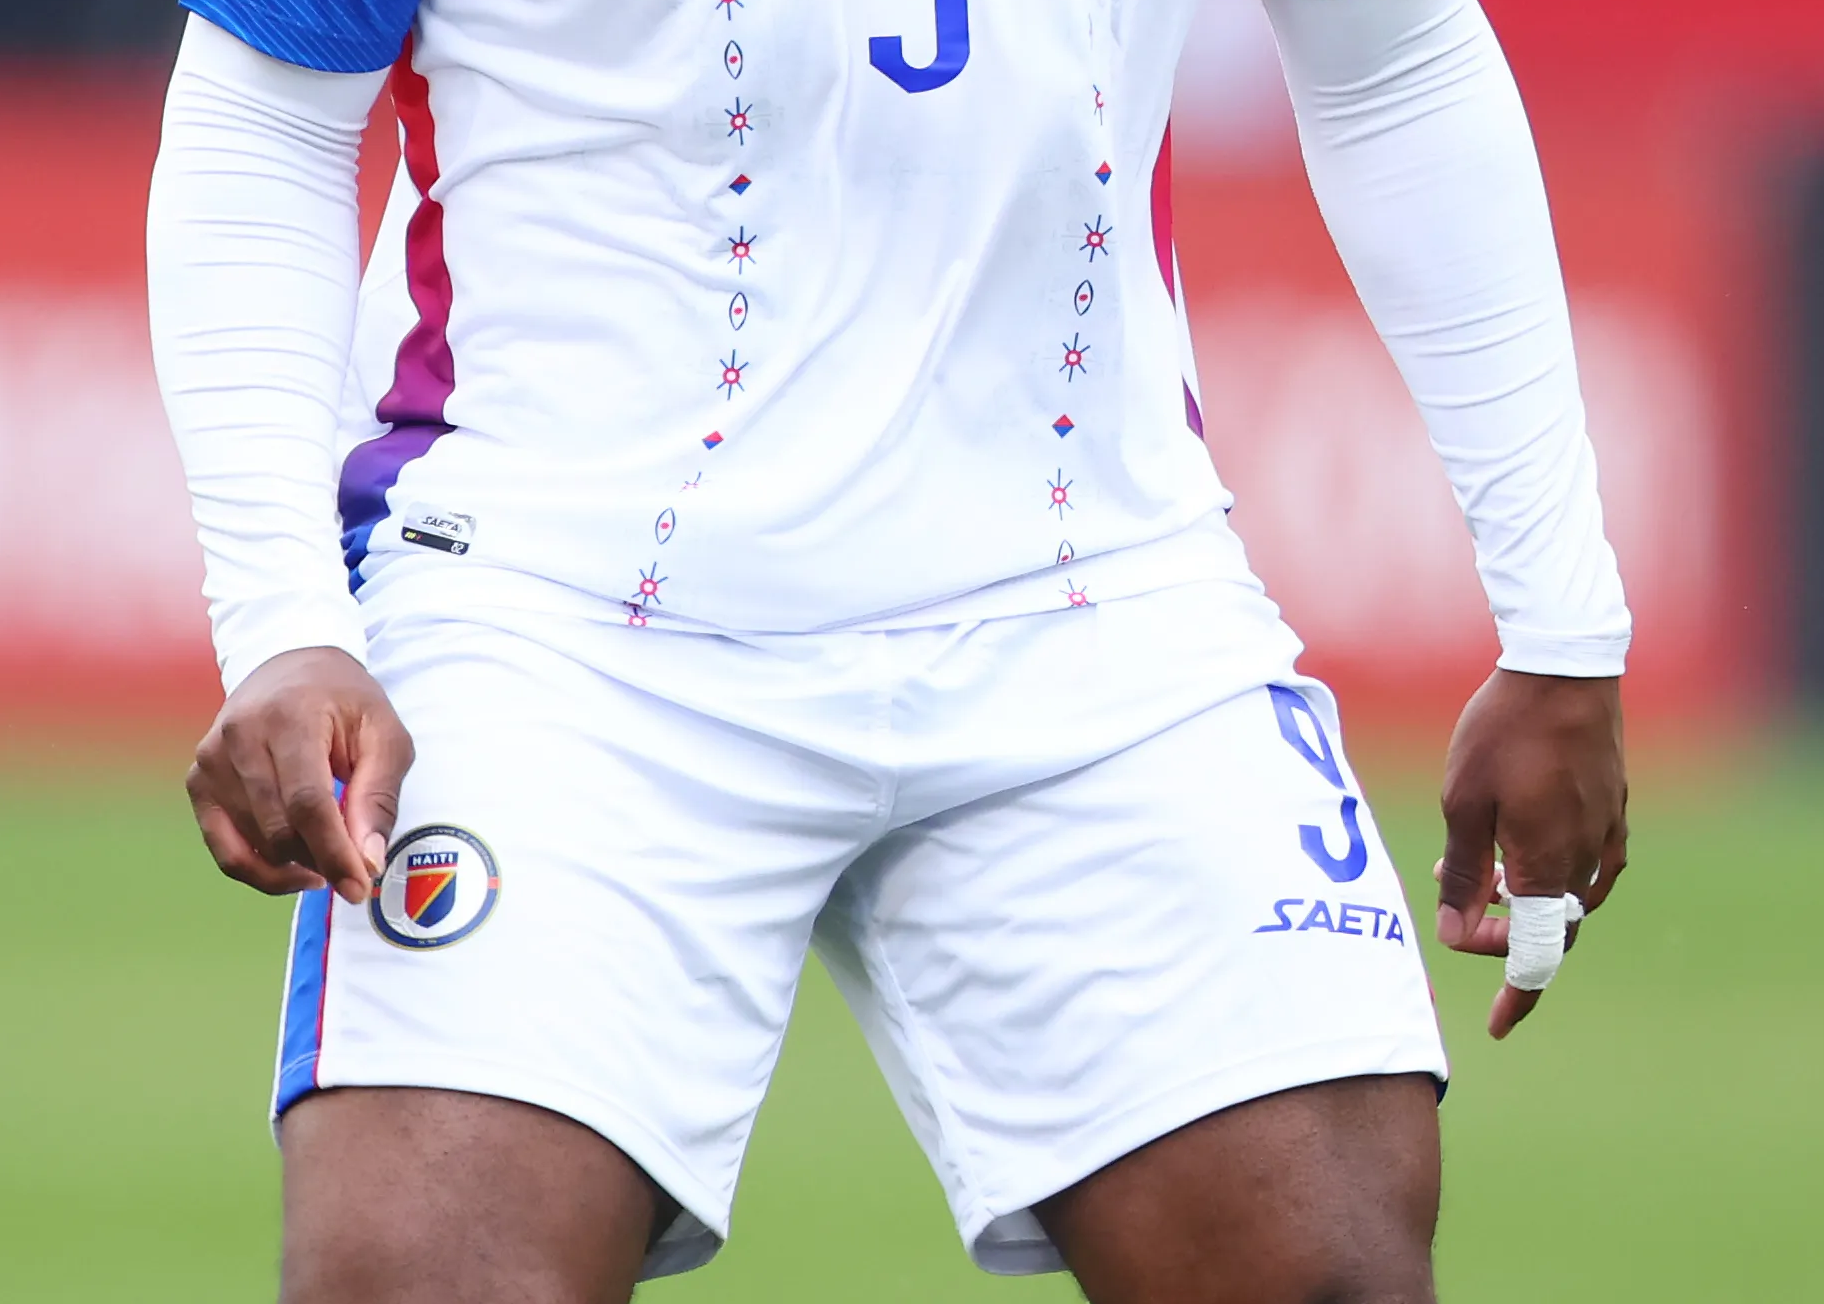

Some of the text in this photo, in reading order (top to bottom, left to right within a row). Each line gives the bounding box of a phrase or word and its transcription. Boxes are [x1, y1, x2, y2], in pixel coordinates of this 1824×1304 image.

[1266, 681, 1368, 884] 9
[412, 853, 454, 866] HAITI
[1252, 899, 1405, 947] SAETA
